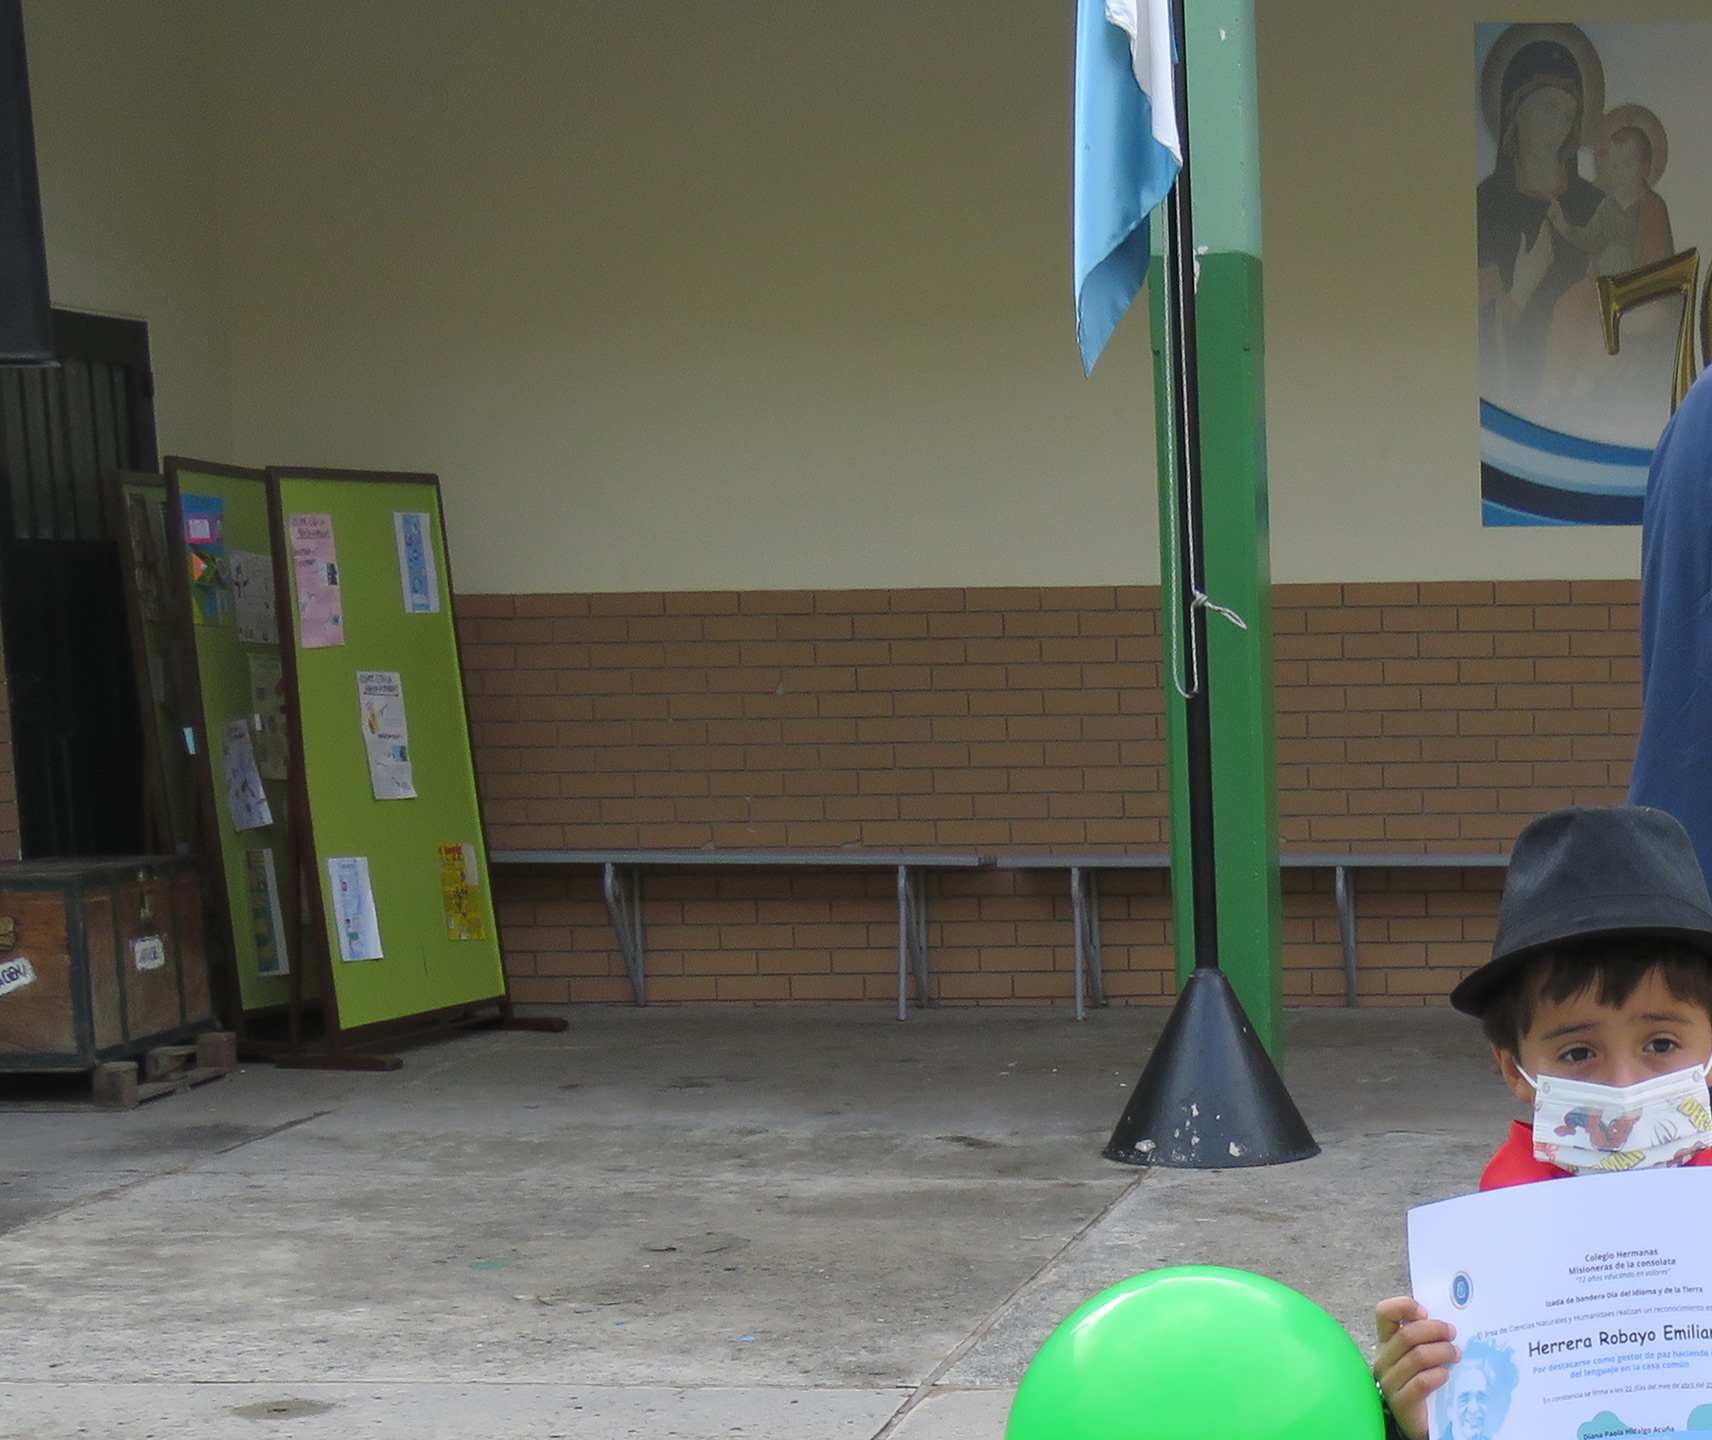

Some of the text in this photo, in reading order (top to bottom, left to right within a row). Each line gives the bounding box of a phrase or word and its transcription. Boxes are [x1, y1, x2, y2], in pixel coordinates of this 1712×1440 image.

[1584, 1248, 1658, 1263] Colegio Hermanas
[1568, 1257, 1676, 1276] Misioneras de la consolata
[1604, 1270, 1635, 1281] educando
[1565, 1297, 1574, 1305] de
[1576, 1293, 1605, 1304] bandera
[1620, 1289, 1631, 1298] del
[1657, 1288, 1663, 1297] y
[1682, 1286, 1703, 1294] Tierra
[1653, 1304, 1705, 1314] reconocimiento
[1528, 1336, 1593, 1358] Herrera
[1599, 1328, 1656, 1347] Robayo
[1533, 1366, 1546, 1375] Por
[1548, 1359, 1591, 1371] destacarse
[1593, 1356, 1616, 1365] como
[1617, 1353, 1643, 1363] gestor
[1644, 1351, 1656, 1360] de
[1657, 1351, 1671, 1360] paz
[1672, 1349, 1710, 1358] haciendo
[1570, 1370, 1583, 1379] del
[1584, 1366, 1619, 1378] lenguaje
[1620, 1364, 1631, 1372] en
[1632, 1363, 1641, 1371] la
[1642, 1361, 1661, 1370] casa
[1625, 1385, 1633, 1393] 22
[1583, 1431, 1604, 1440] Diana
[1604, 1428, 1624, 1438] Paola
[1624, 1426, 1652, 1436] Hidalgo
